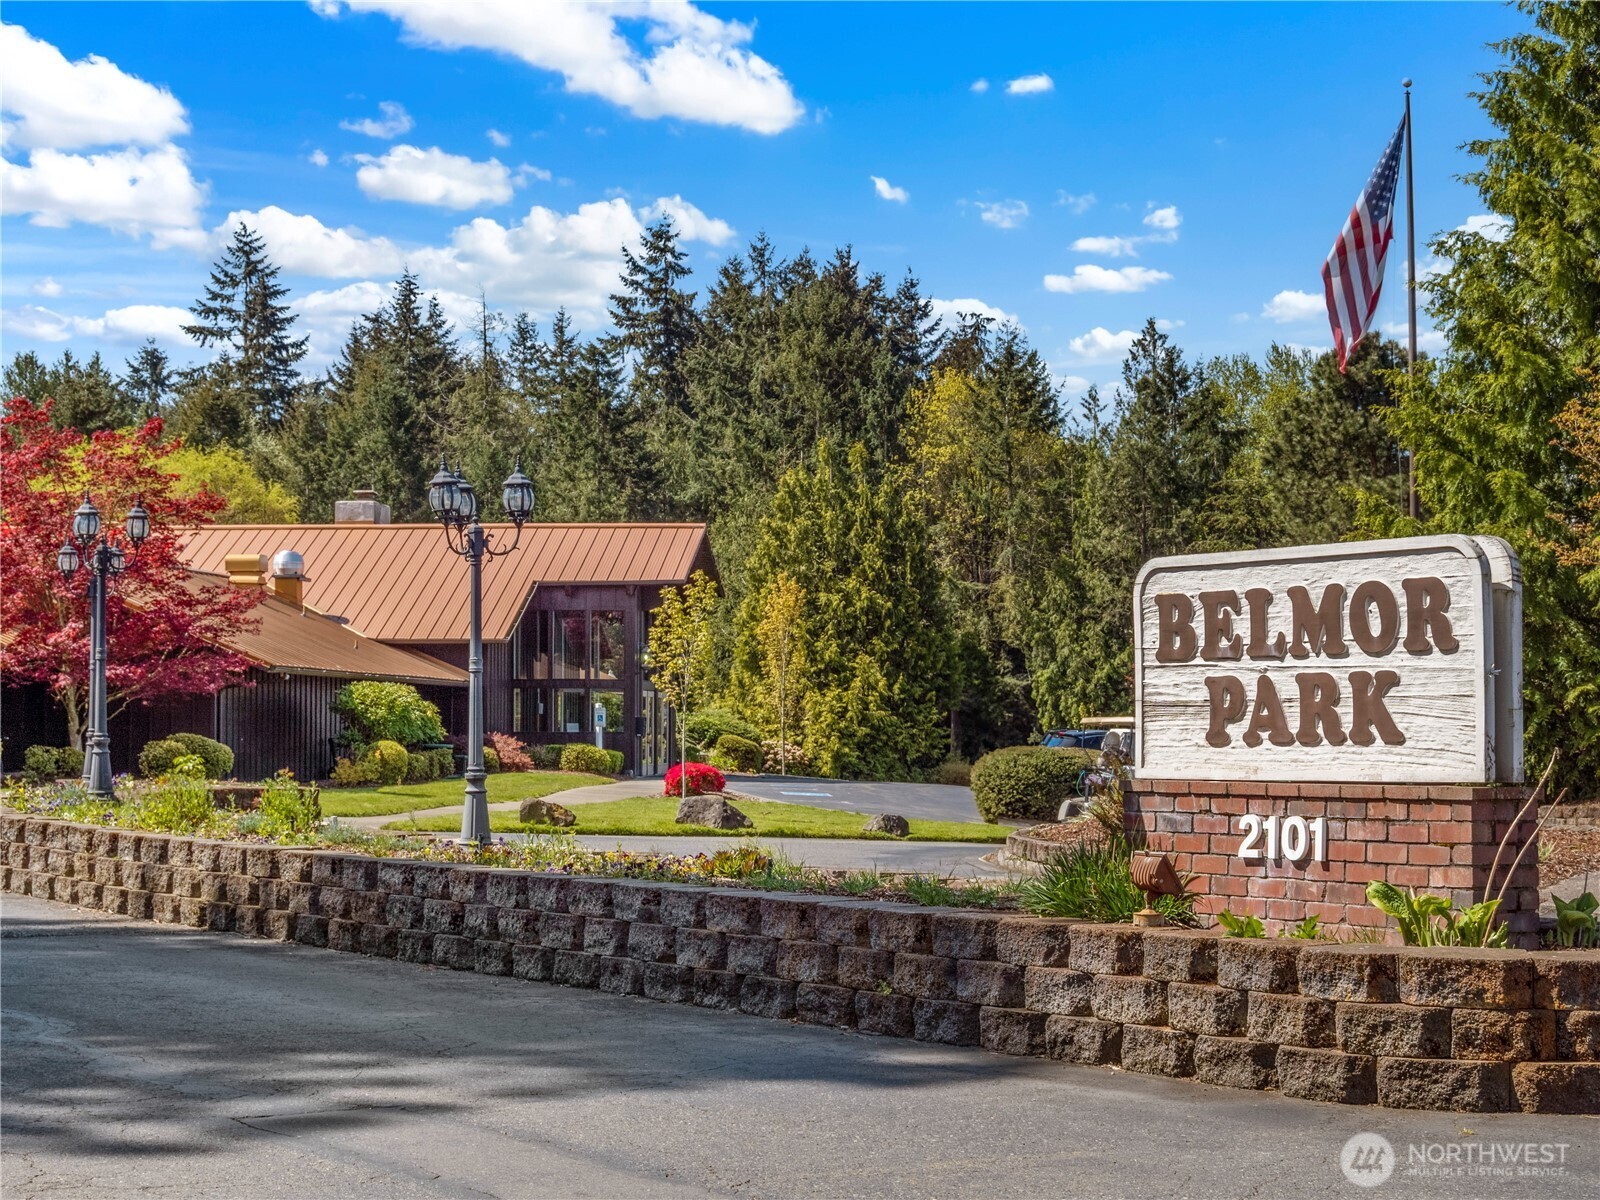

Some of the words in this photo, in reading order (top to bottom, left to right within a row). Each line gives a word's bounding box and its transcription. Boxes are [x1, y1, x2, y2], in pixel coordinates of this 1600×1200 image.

[1155, 577, 1459, 663] BELMOR
[1205, 671, 1406, 747] PARK
[1238, 815, 1327, 862] 2101
